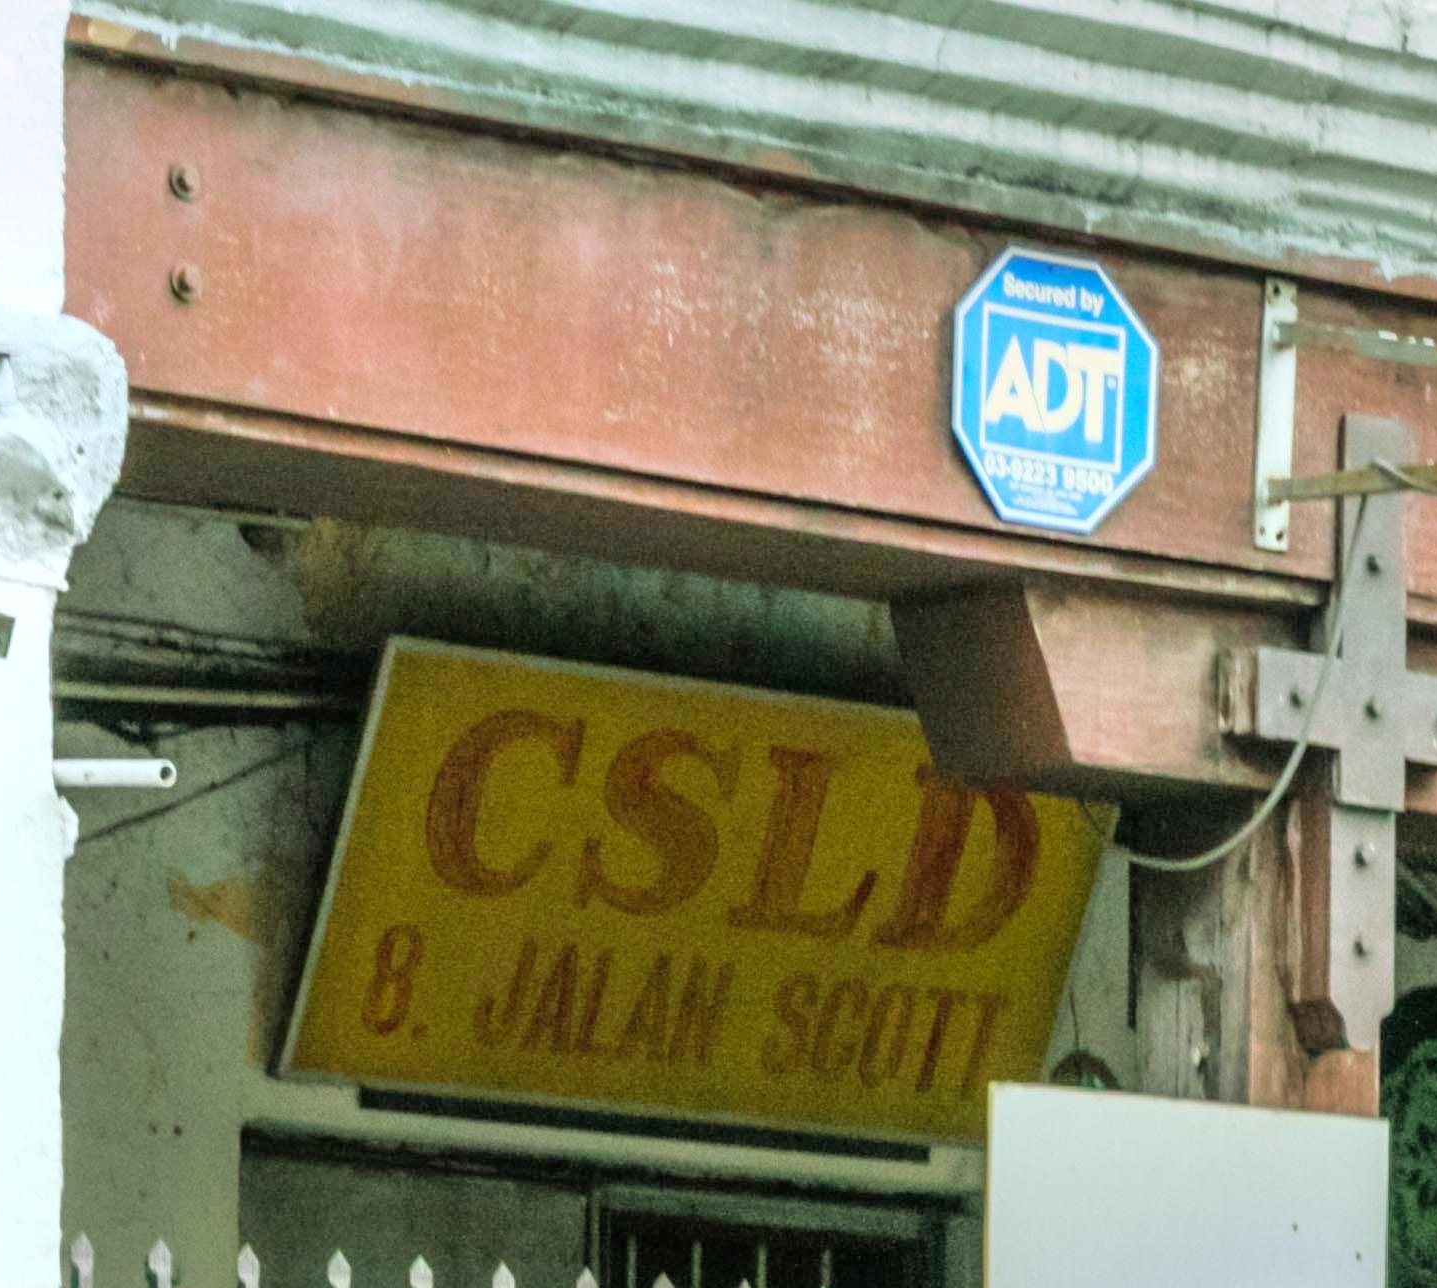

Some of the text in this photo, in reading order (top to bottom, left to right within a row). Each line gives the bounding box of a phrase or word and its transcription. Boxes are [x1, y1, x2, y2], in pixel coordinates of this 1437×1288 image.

[1003, 271, 1105, 318] Secured by
[984, 334, 1121, 443] ADT
[424, 708, 1041, 953] CSLD
[474, 936, 735, 1065] JALAN
[763, 972, 1005, 1092] SCOTT
